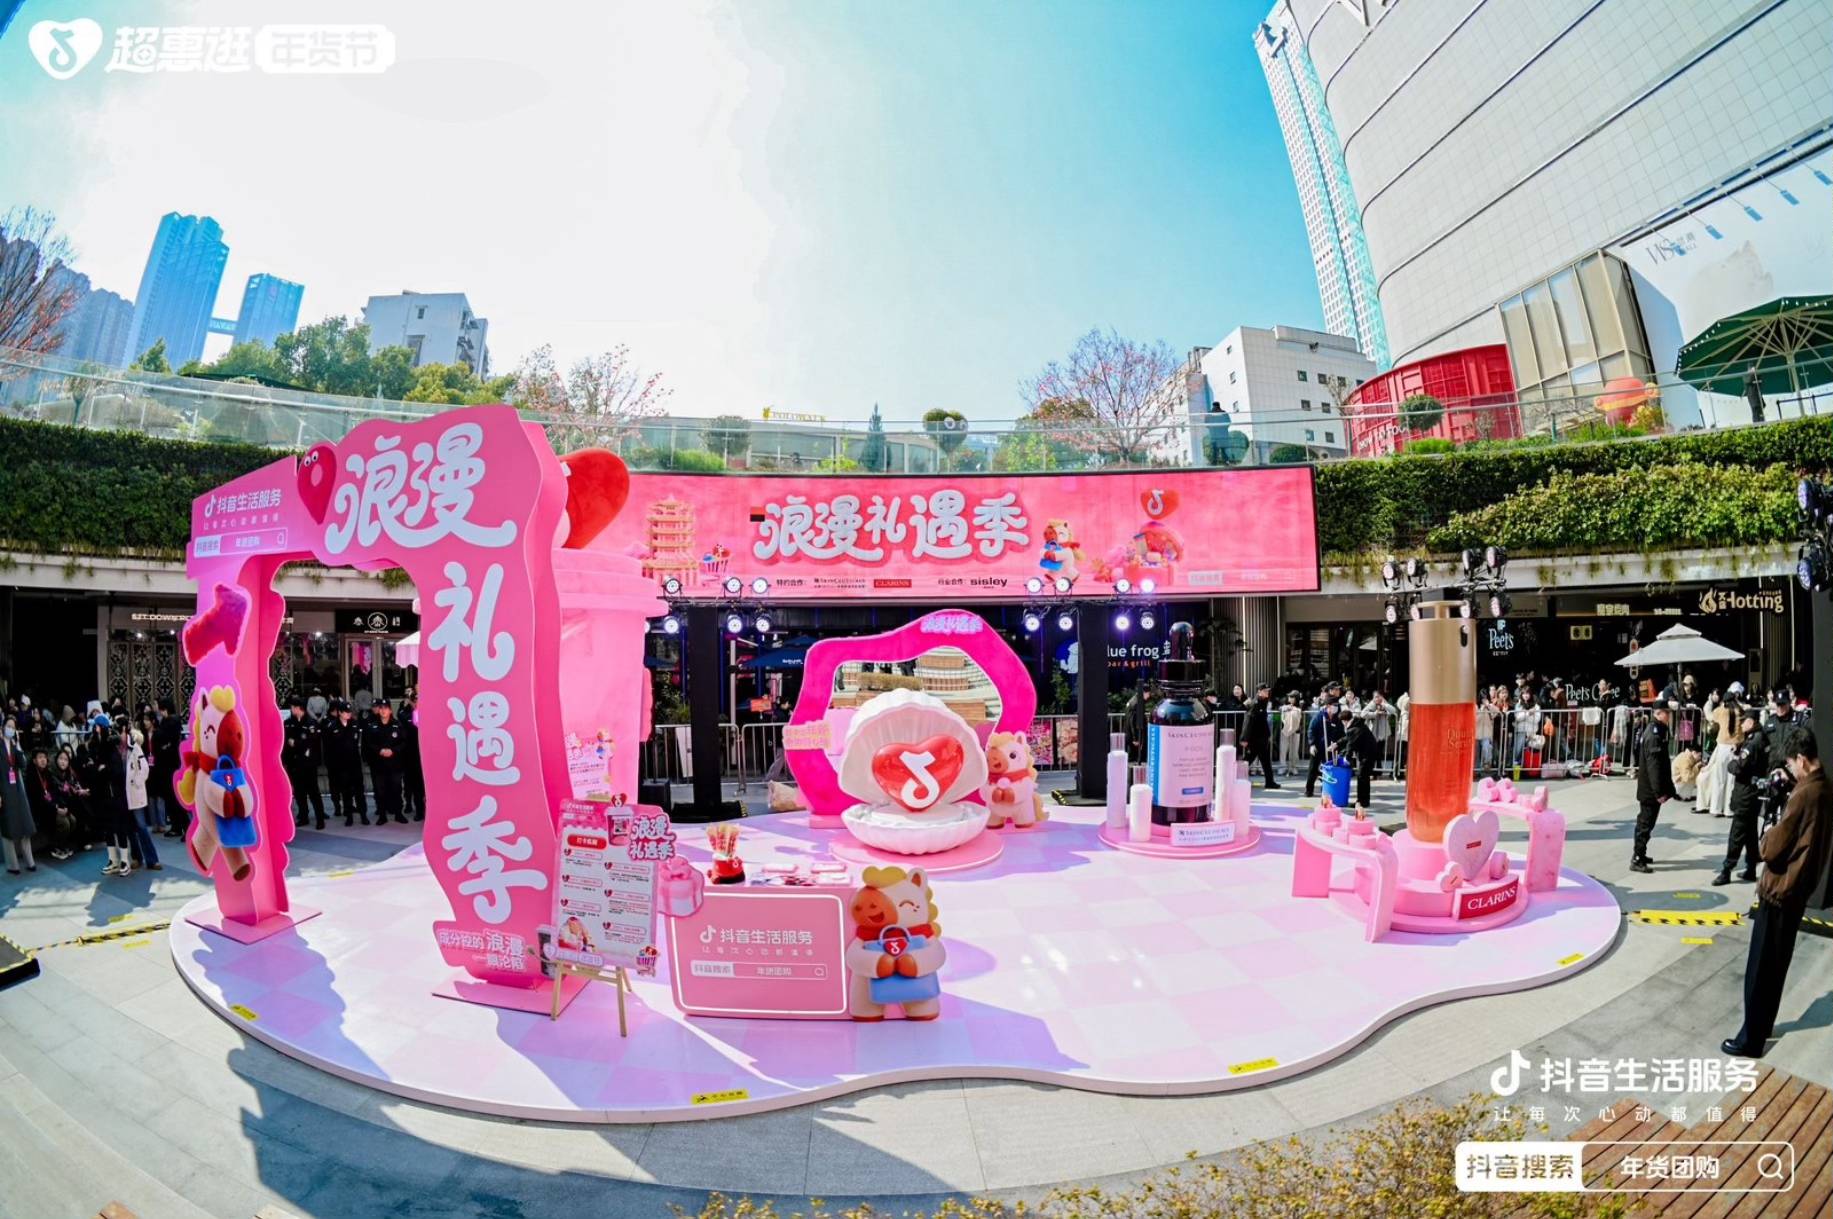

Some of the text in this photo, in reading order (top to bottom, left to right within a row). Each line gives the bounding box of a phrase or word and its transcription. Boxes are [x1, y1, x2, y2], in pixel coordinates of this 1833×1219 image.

[325, 423, 517, 553] 浪漫
[216, 489, 282, 514] 抖音生活服务
[754, 490, 1030, 560] 浪漫礼遇季
[970, 577, 1008, 588] sisley
[1107, 642, 1160, 660] lue frog
[428, 563, 547, 924] 礼遇季
[631, 816, 676, 841] 浪漫
[631, 841, 675, 860] 礼遇季
[1467, 885, 1516, 910] CLARINS
[486, 931, 524, 957] 浪漫
[720, 928, 813, 945] 抖音生活服务
